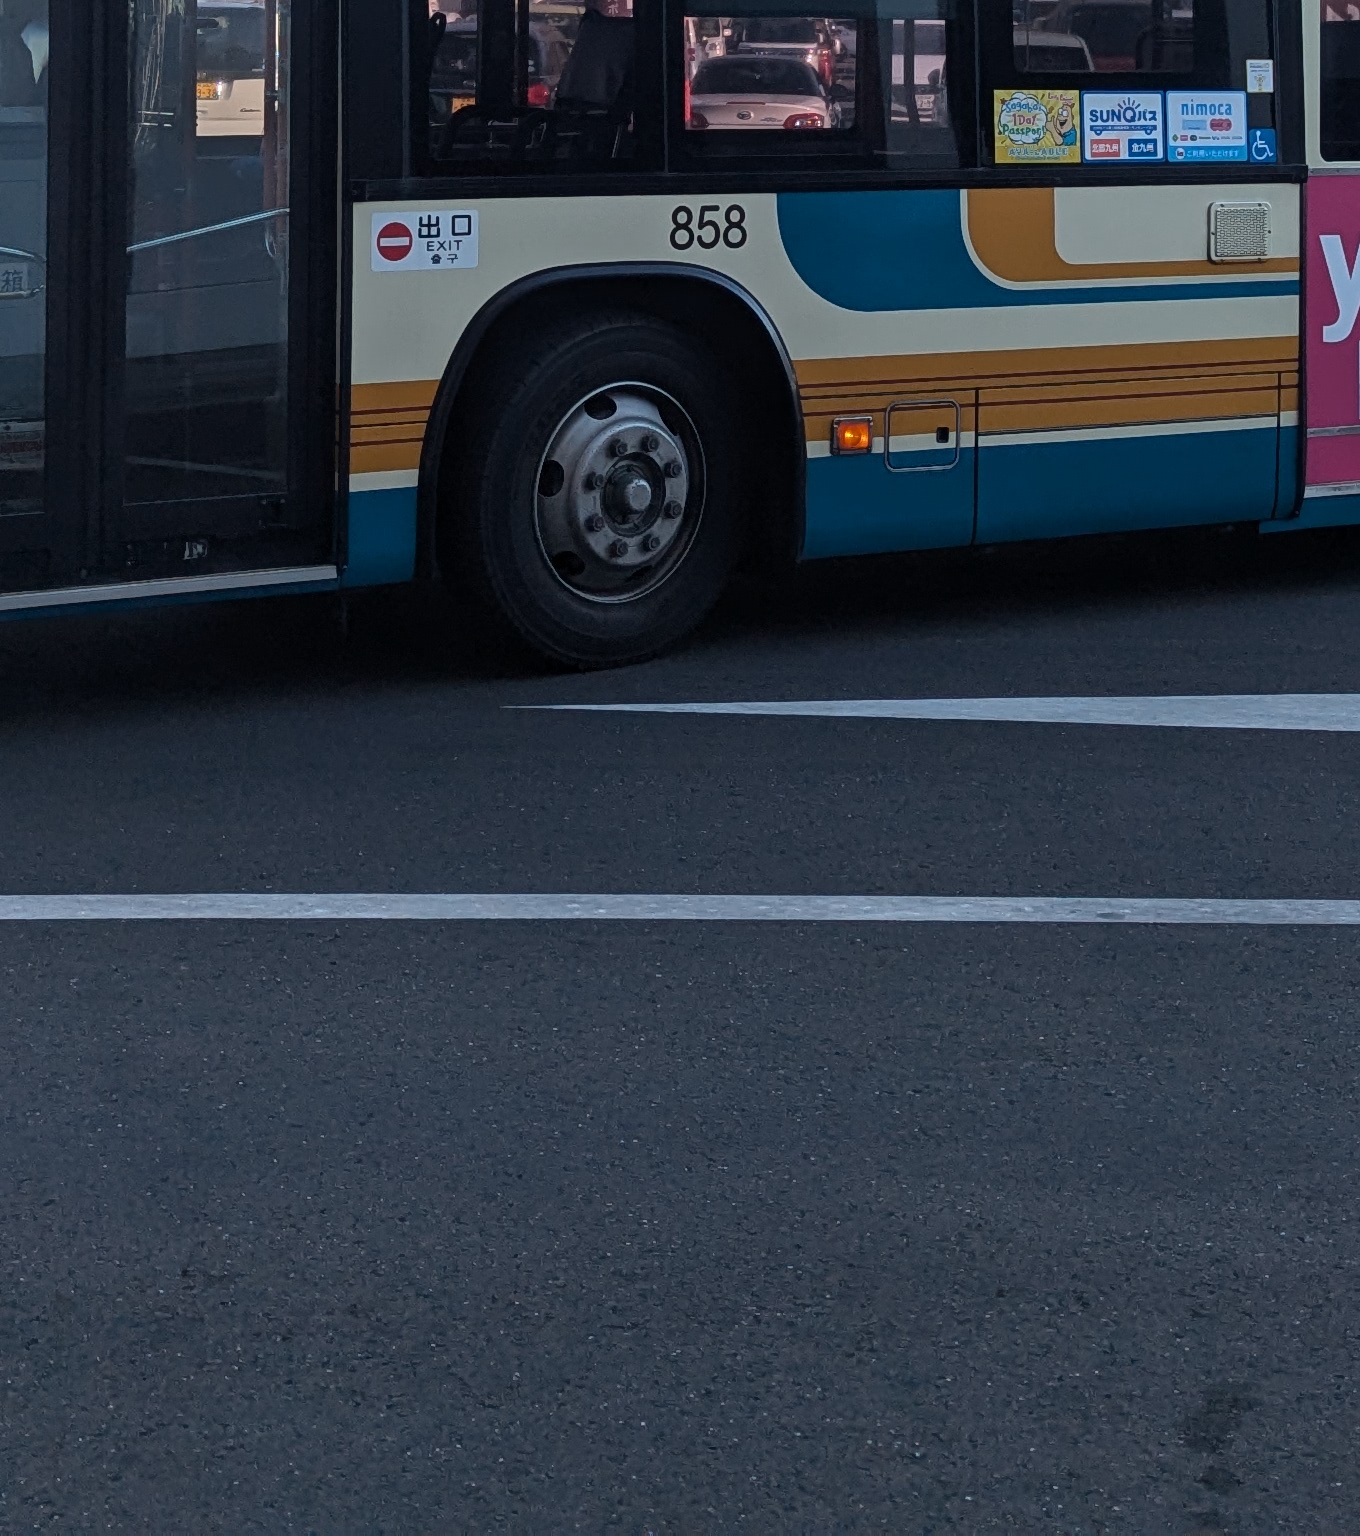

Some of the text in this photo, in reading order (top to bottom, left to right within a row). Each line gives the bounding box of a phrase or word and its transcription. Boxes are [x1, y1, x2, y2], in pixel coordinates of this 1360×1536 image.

[1181, 99, 1232, 116] nimoca
[418, 214, 472, 239] 出口
[669, 204, 747, 250] 858
[426, 240, 462, 251] EXIT
